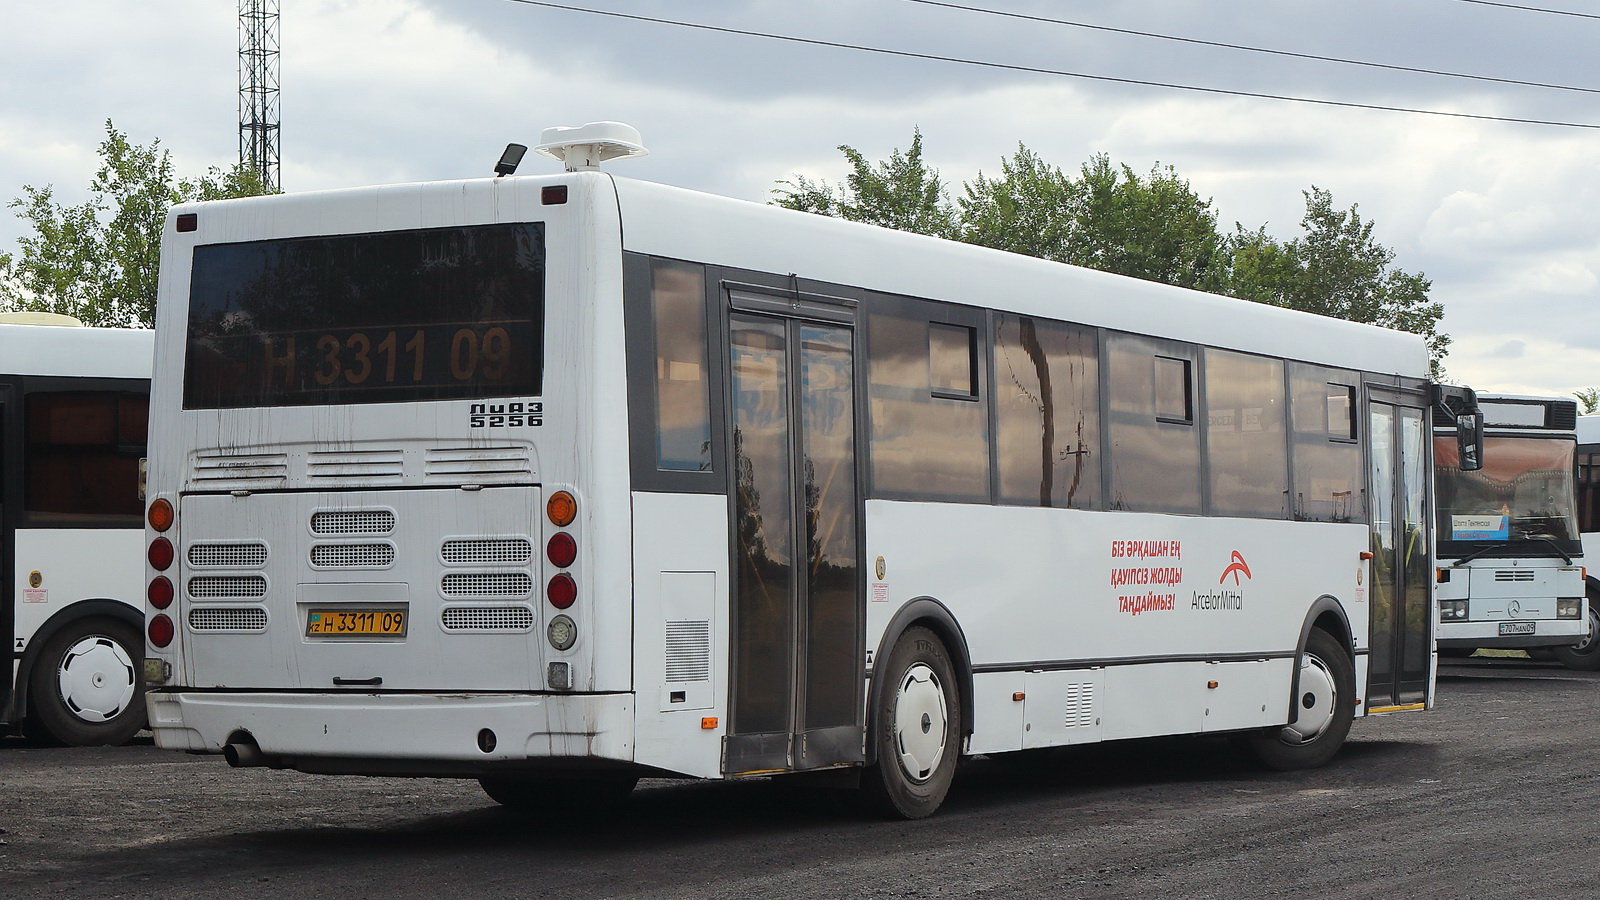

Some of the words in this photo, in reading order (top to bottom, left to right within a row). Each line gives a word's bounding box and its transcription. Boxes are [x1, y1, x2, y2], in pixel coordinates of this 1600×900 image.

[314, 330, 426, 385] 3311
[451, 327, 511, 381] 09
[470, 415, 543, 427] 5256
[1112, 541, 1125, 557] БІЗ
[1126, 540, 1168, 560] ӘРҚАШАН
[1170, 540, 1181, 560] ЕҢ
[1111, 568, 1149, 589] ҚАУІПСІЗ
[1149, 567, 1182, 587] ЖОЛДЫ
[1118, 591, 1175, 615] ТАҢДАЙМЫЗ!
[1191, 589, 1243, 610] ArcelorMittal
[309, 624, 320, 632] KZ
[324, 617, 334, 632] H
[338, 613, 375, 631] 3311
[383, 613, 403, 631] 09
